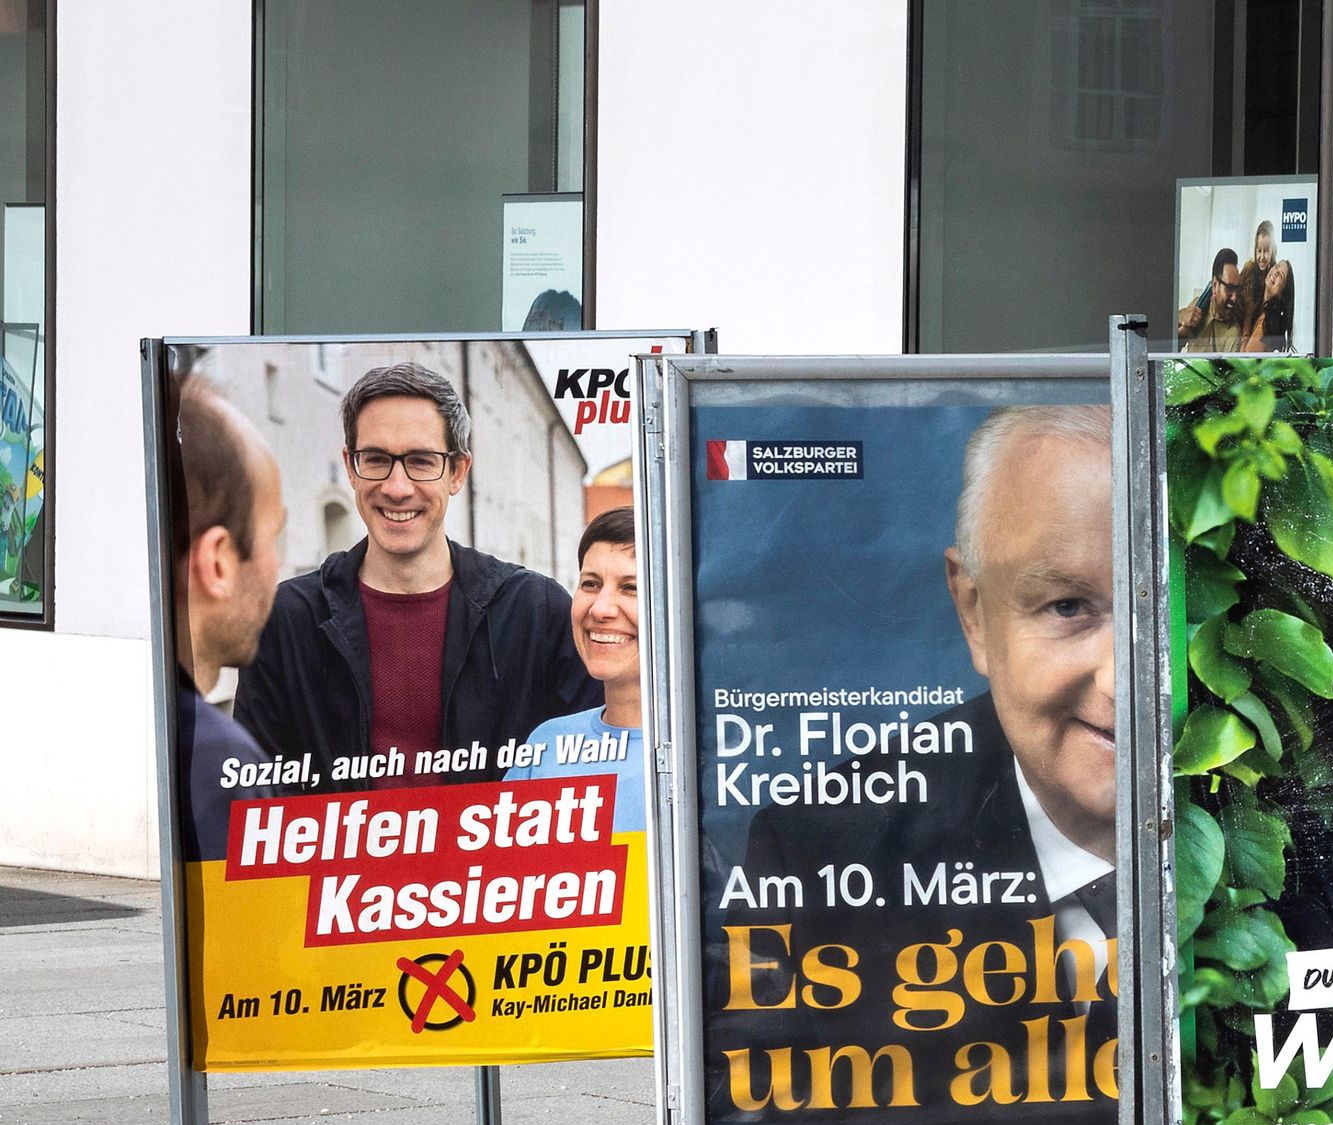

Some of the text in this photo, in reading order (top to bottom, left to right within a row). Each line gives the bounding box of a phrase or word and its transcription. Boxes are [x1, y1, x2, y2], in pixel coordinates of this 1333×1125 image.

[1283, 211, 1306, 223] HYPO
[574, 390, 630, 435] plu
[752, 446, 857, 461] SALZBURGER
[752, 460, 858, 475] VOLKSPARTEI
[714, 686, 964, 709] Bürgermeisterkandidat
[716, 711, 973, 758] Dr. Florian
[220, 731, 629, 790] Sozial, auch nach der Wahl
[717, 760, 928, 806] Kreibich
[240, 785, 604, 867] Helfen statt
[316, 867, 617, 936] Kassieren
[719, 861, 1037, 909] Am 10. März:
[493, 942, 567, 990] KPÖ
[721, 923, 862, 1010] Es
[218, 985, 386, 1020] Am 10. März
[491, 990, 608, 1019] Kay-Michael
[721, 1014, 1119, 1112] um all
